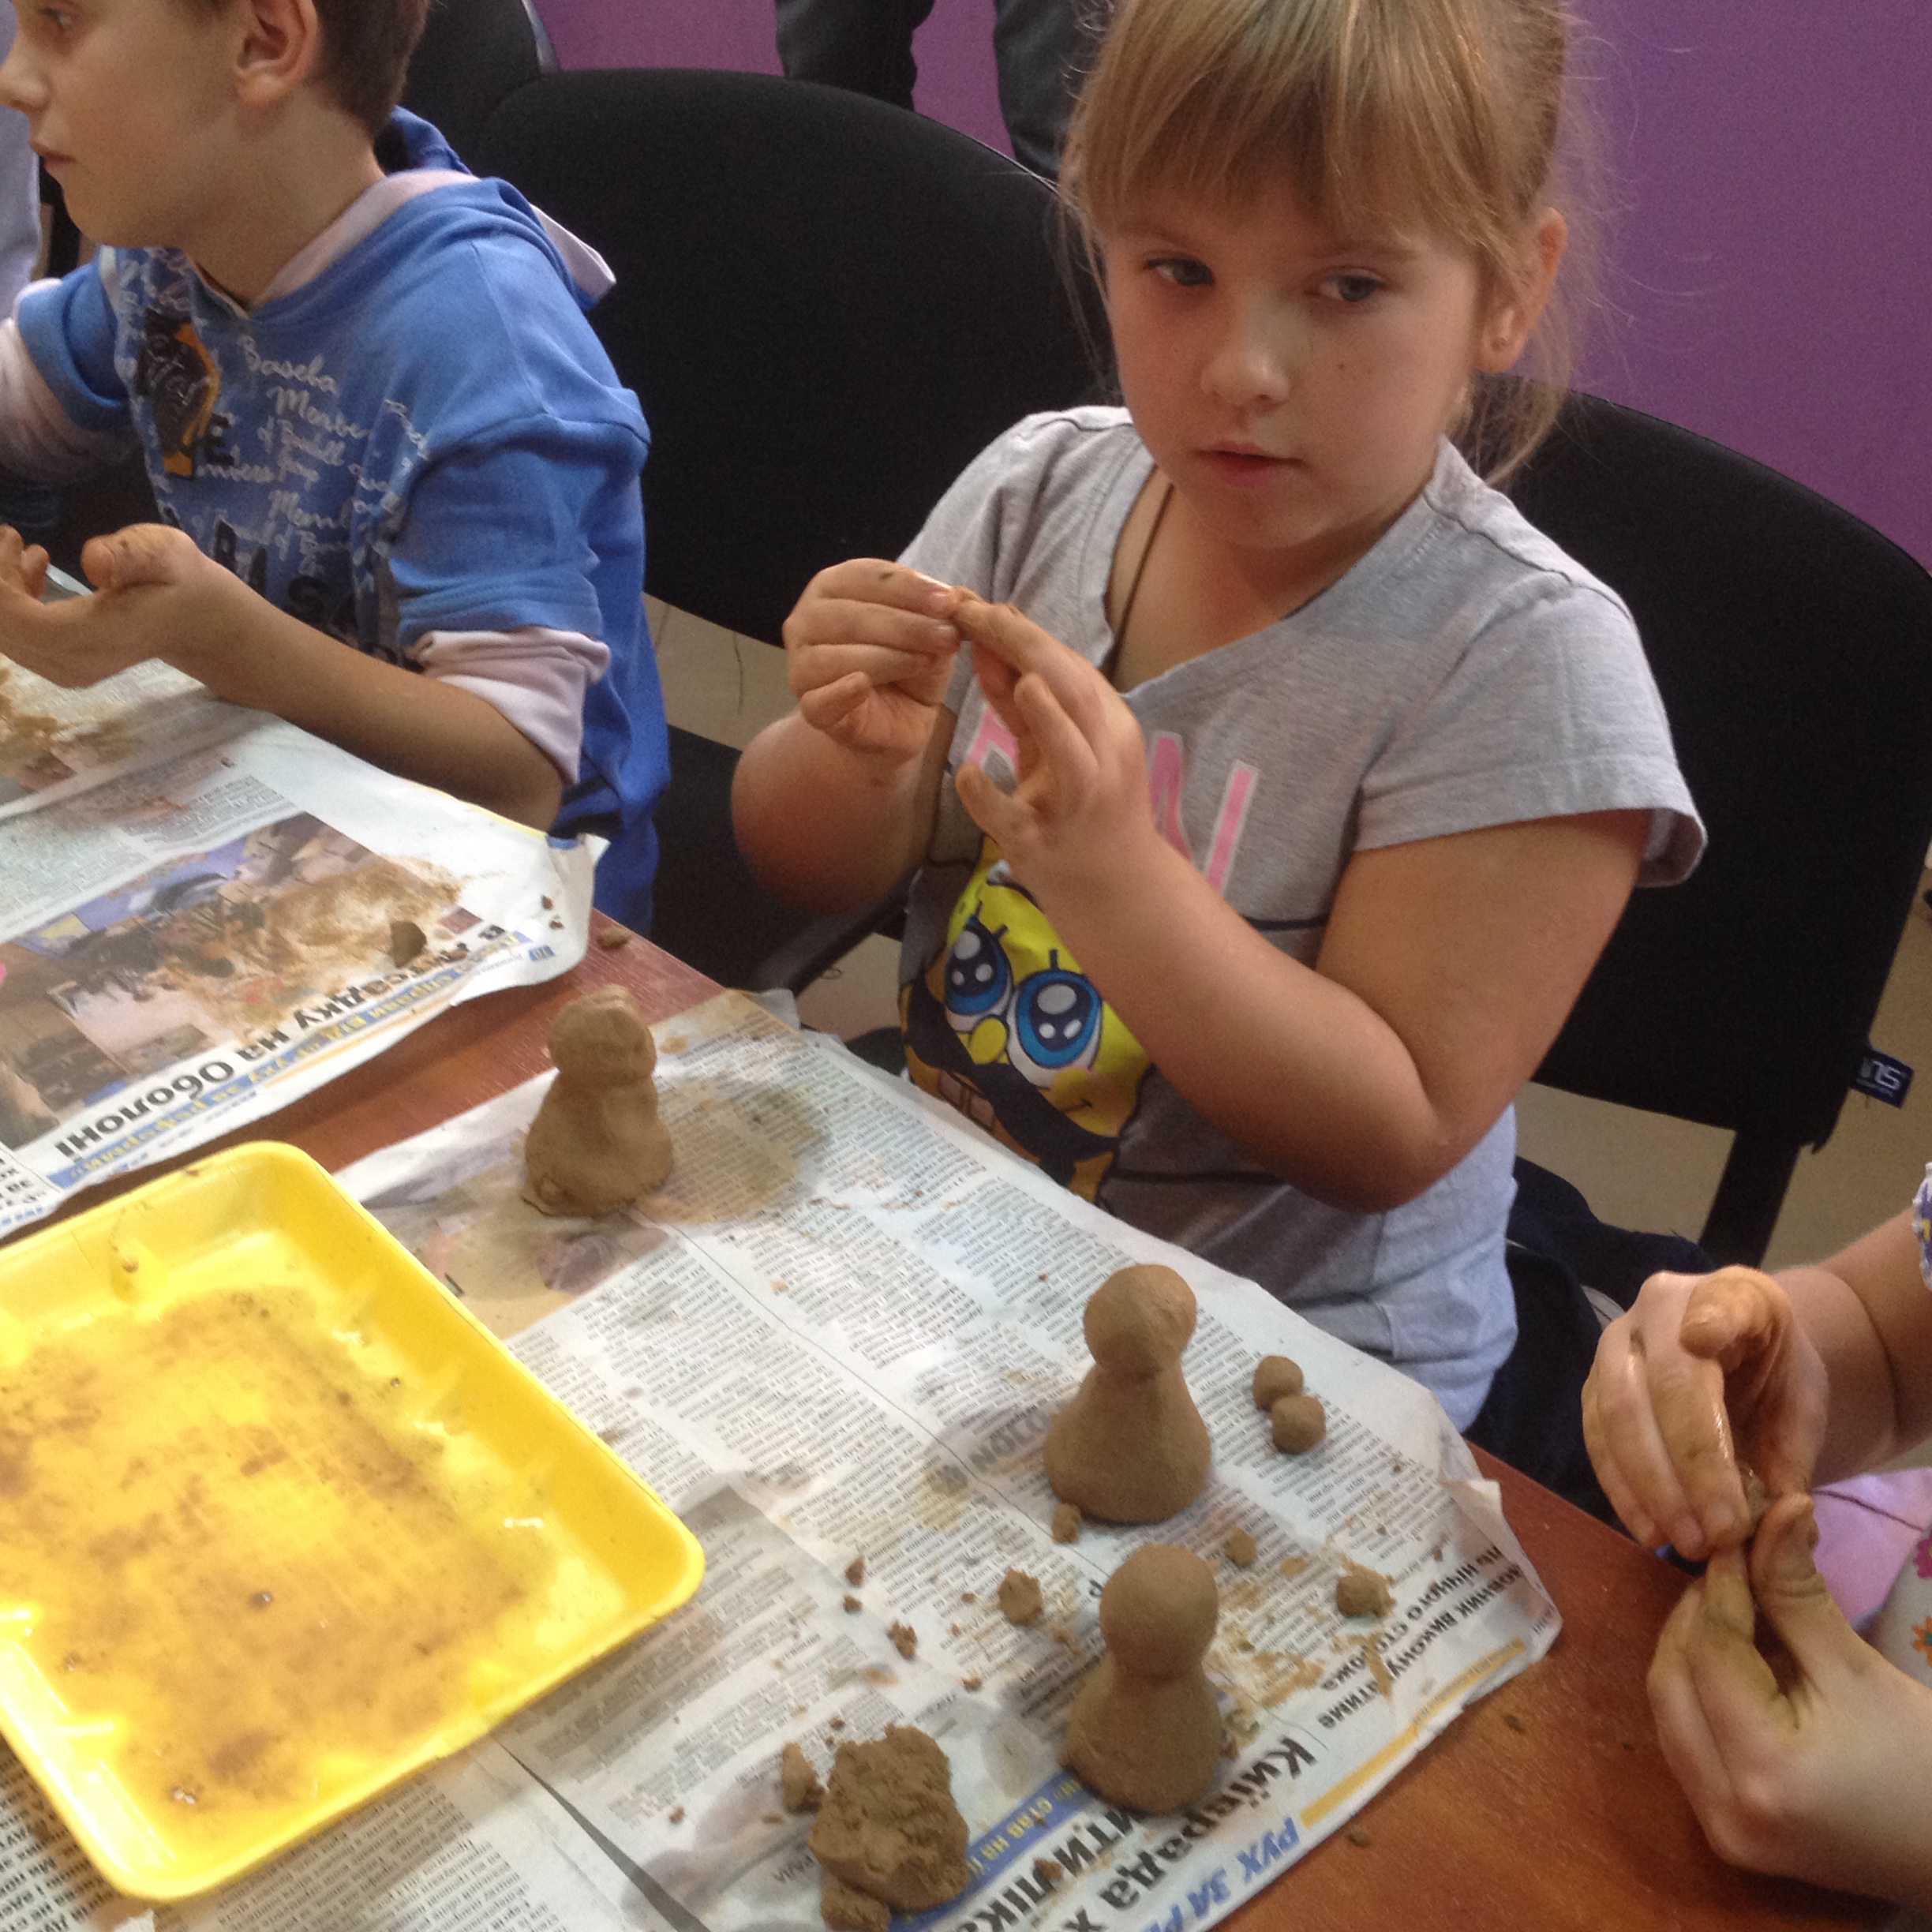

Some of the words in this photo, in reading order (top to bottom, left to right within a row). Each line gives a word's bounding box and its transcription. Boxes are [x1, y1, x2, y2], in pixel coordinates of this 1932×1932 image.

[237, 1029, 290, 1062] на
[54, 1061, 235, 1163] Оболоні
[1318, 1611, 1458, 1729] виконуатиме
[1236, 1817, 1301, 1885] РУХ
[1186, 1866, 1232, 1920] ЗА
